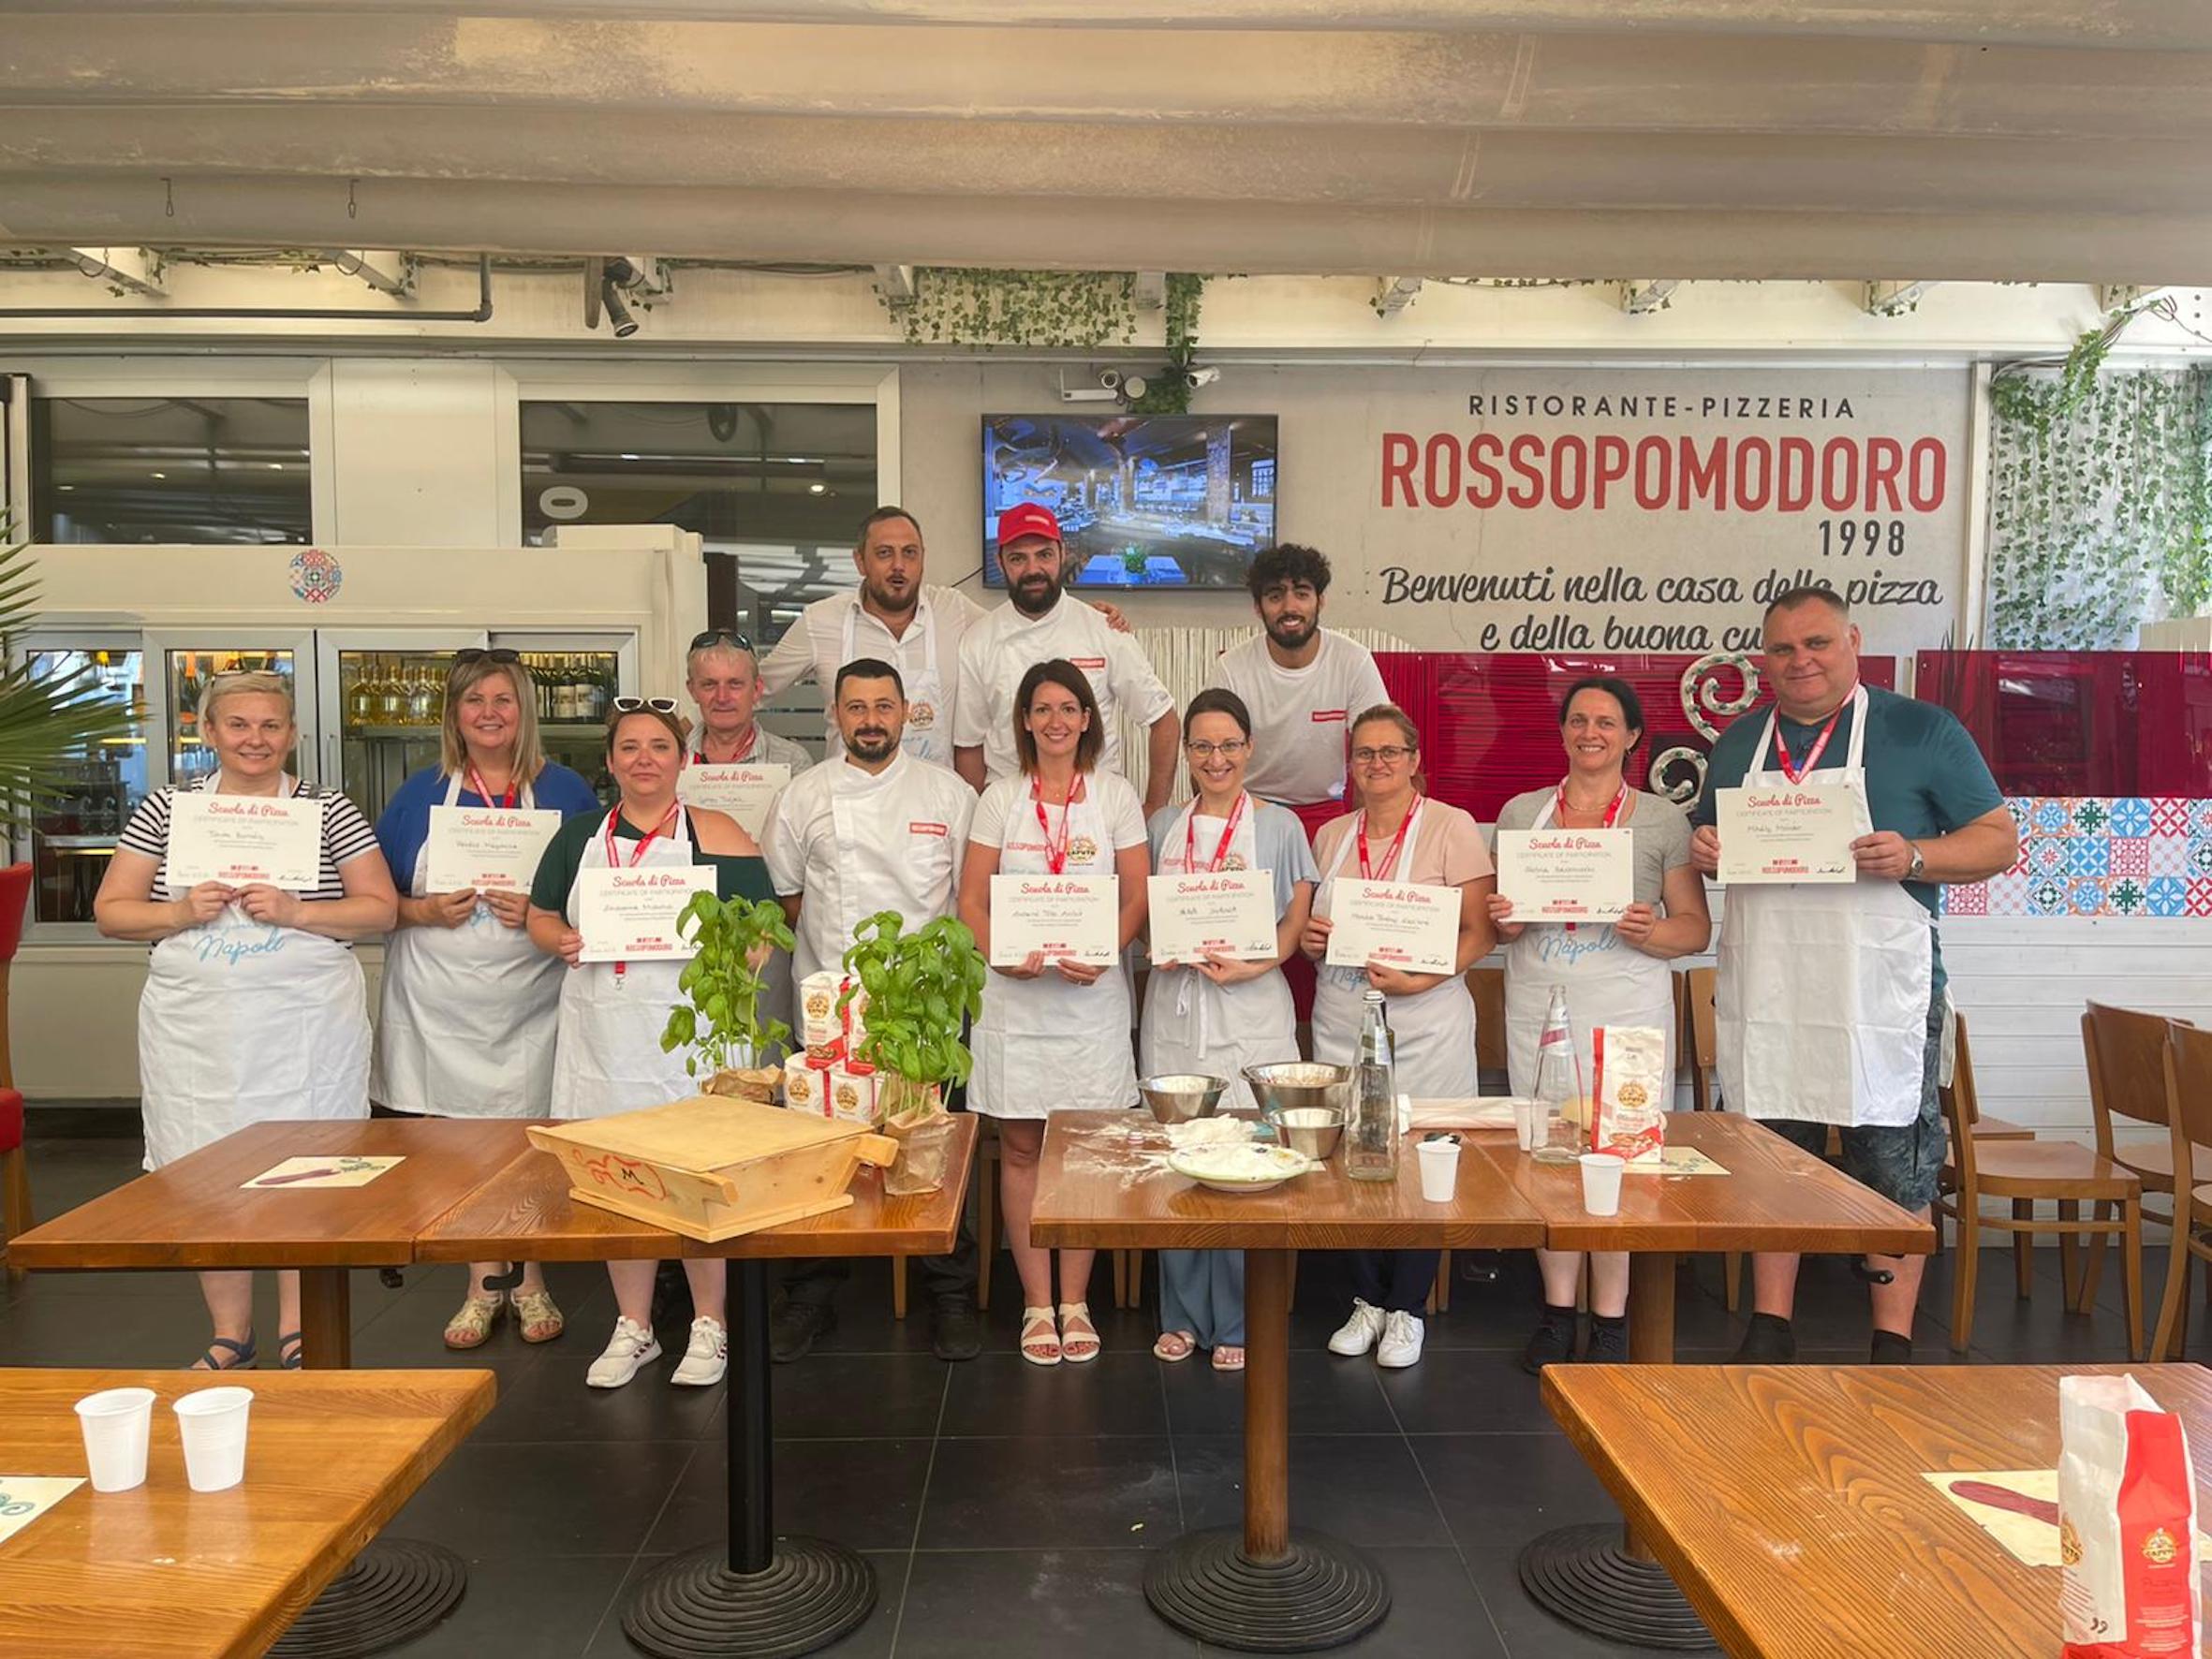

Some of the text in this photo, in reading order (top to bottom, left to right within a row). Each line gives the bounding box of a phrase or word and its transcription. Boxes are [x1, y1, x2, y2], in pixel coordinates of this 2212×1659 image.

[1468, 394, 1854, 418] RISTORANTE-PIZZERIA
[1381, 433, 1946, 512] ROSSOPOMODORO
[1819, 520, 1905, 556] 1998
[1379, 566, 1555, 605] Benvenuti
[1563, 566, 1648, 604] nella
[1657, 577, 1744, 604] casa
[1845, 569, 1943, 609] pizza
[1480, 623, 1500, 651] e
[1510, 614, 1595, 651] della
[1603, 615, 1714, 652] buona
